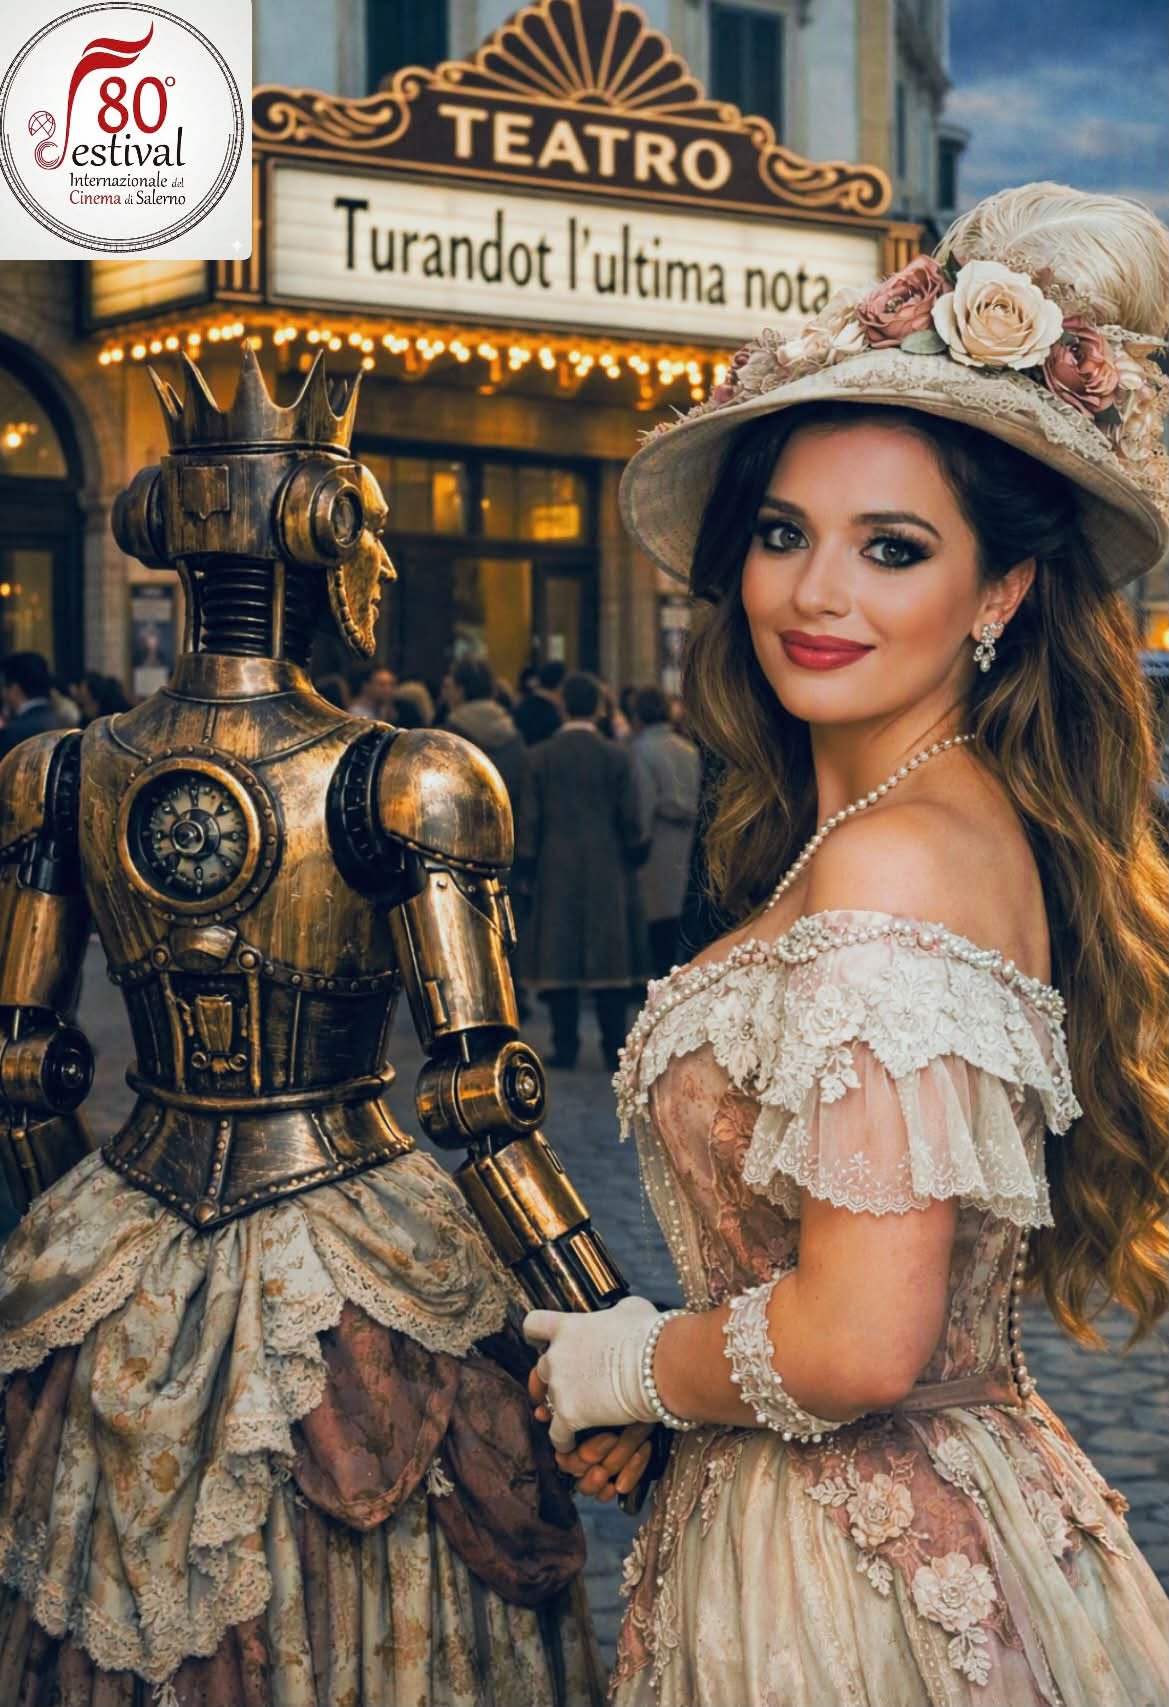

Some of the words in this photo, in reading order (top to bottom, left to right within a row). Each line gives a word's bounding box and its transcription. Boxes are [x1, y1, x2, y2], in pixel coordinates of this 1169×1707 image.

[438, 104, 733, 191] TEATRO
[334, 196, 553, 289] Turandot
[568, 217, 726, 305] l'ultima
[744, 262, 831, 316] nota
